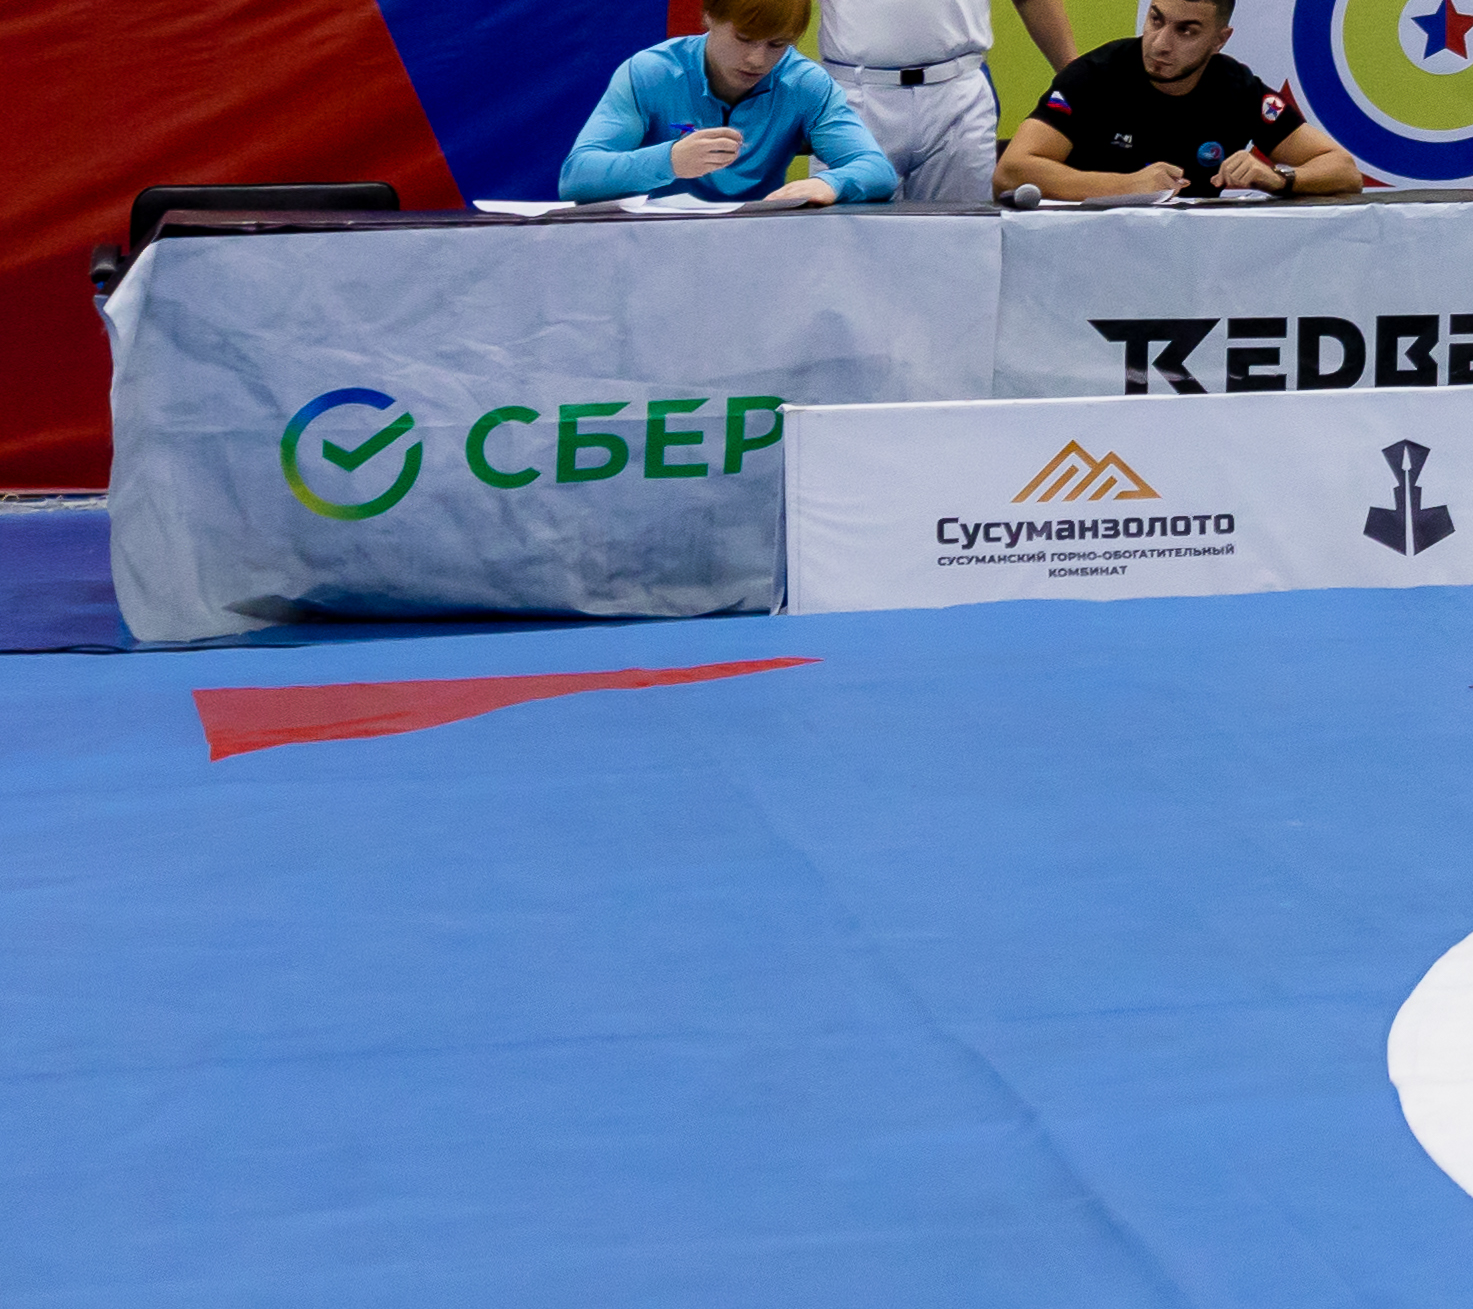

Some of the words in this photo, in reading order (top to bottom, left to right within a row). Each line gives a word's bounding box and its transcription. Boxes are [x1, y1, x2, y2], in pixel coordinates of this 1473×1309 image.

[465, 395, 786, 489] СБЕР
[936, 513, 1236, 549] Сусуманзолото
[937, 551, 1046, 567] СУСУМАНСКИЙ
[1050, 543, 1235, 563] ГОРНО-ОБОГАТИТЕЛЬНЫЙ
[1048, 564, 1128, 578] КОМБИНАТ
